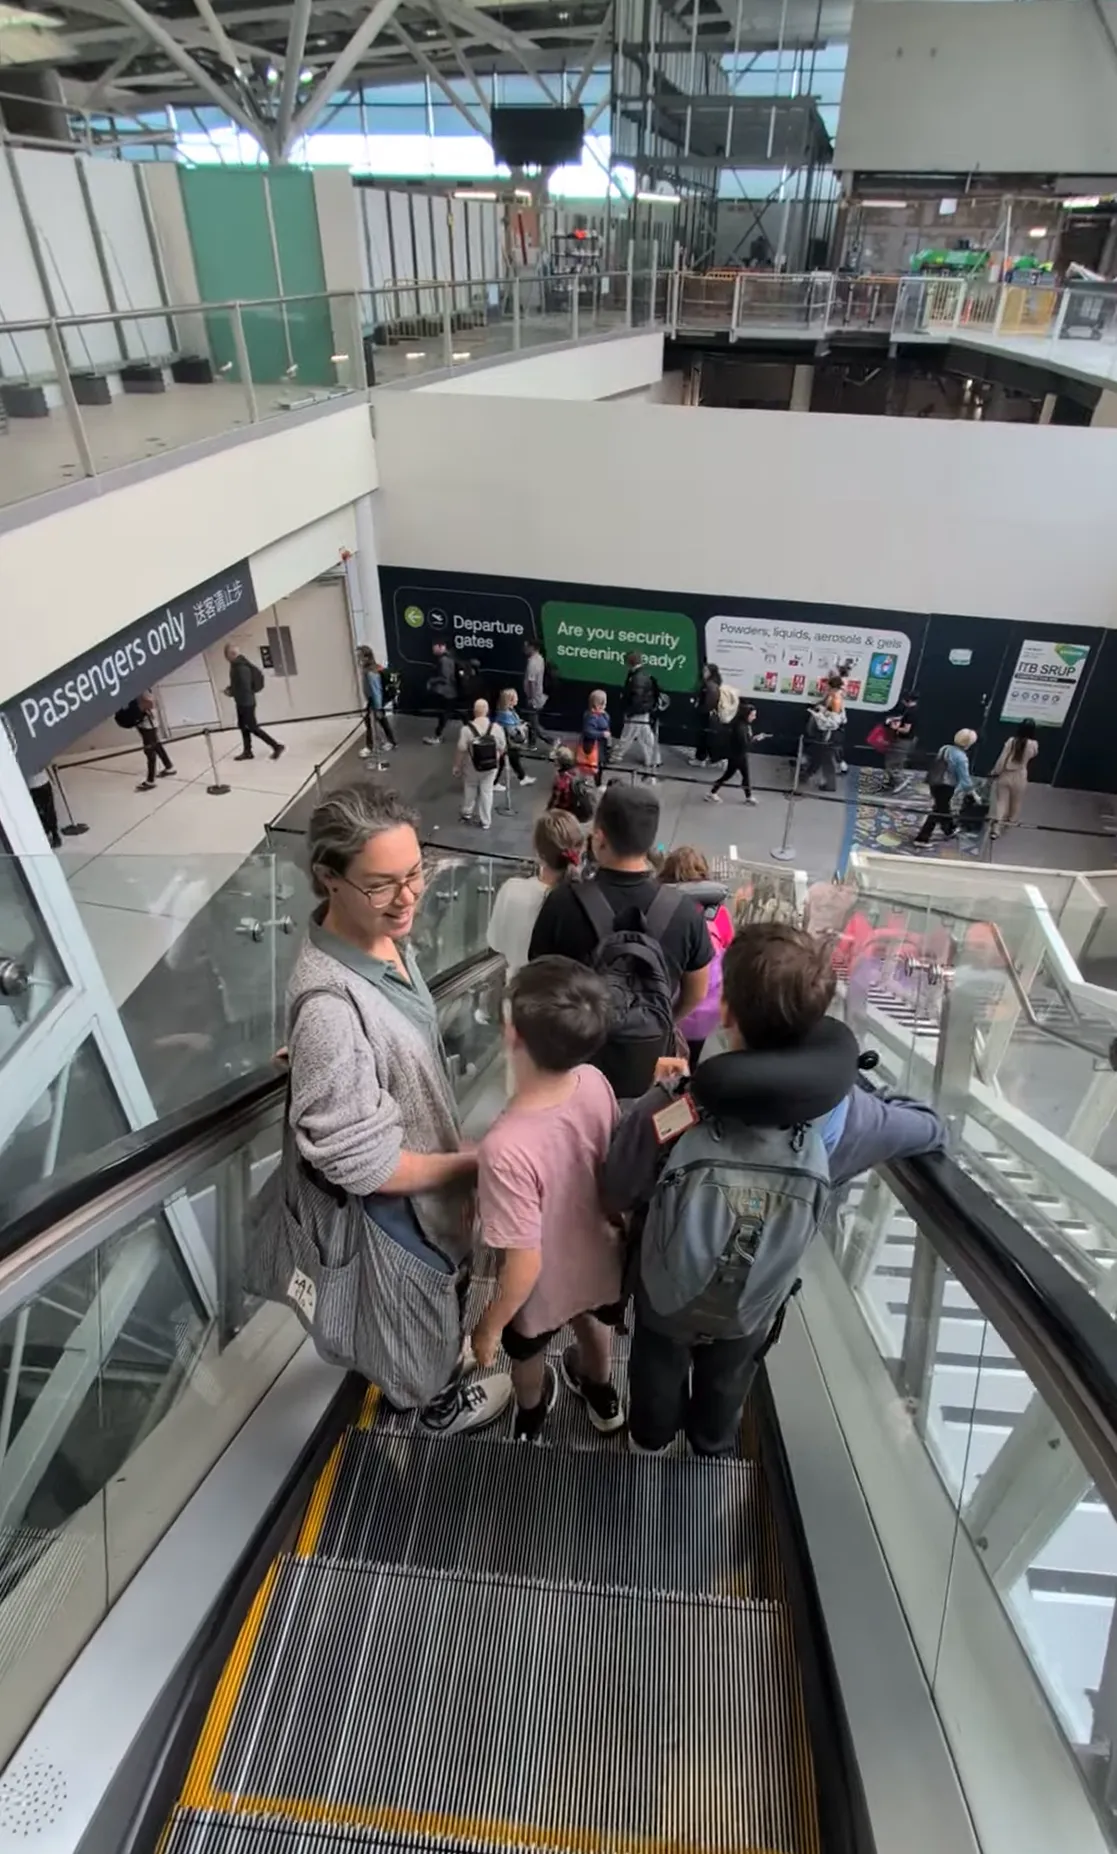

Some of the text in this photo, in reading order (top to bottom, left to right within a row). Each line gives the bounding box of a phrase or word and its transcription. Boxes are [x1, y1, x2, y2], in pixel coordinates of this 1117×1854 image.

[453, 615, 524, 636] Departure
[557, 621, 680, 650] Are you security
[720, 622, 902, 649] Powders, liquids, aerosols & gels
[454, 634, 494, 650] gates
[640, 653, 687, 671] eady?
[1018, 661, 1076, 677] ITB SRUP
[20, 608, 186, 738] Passengers only
